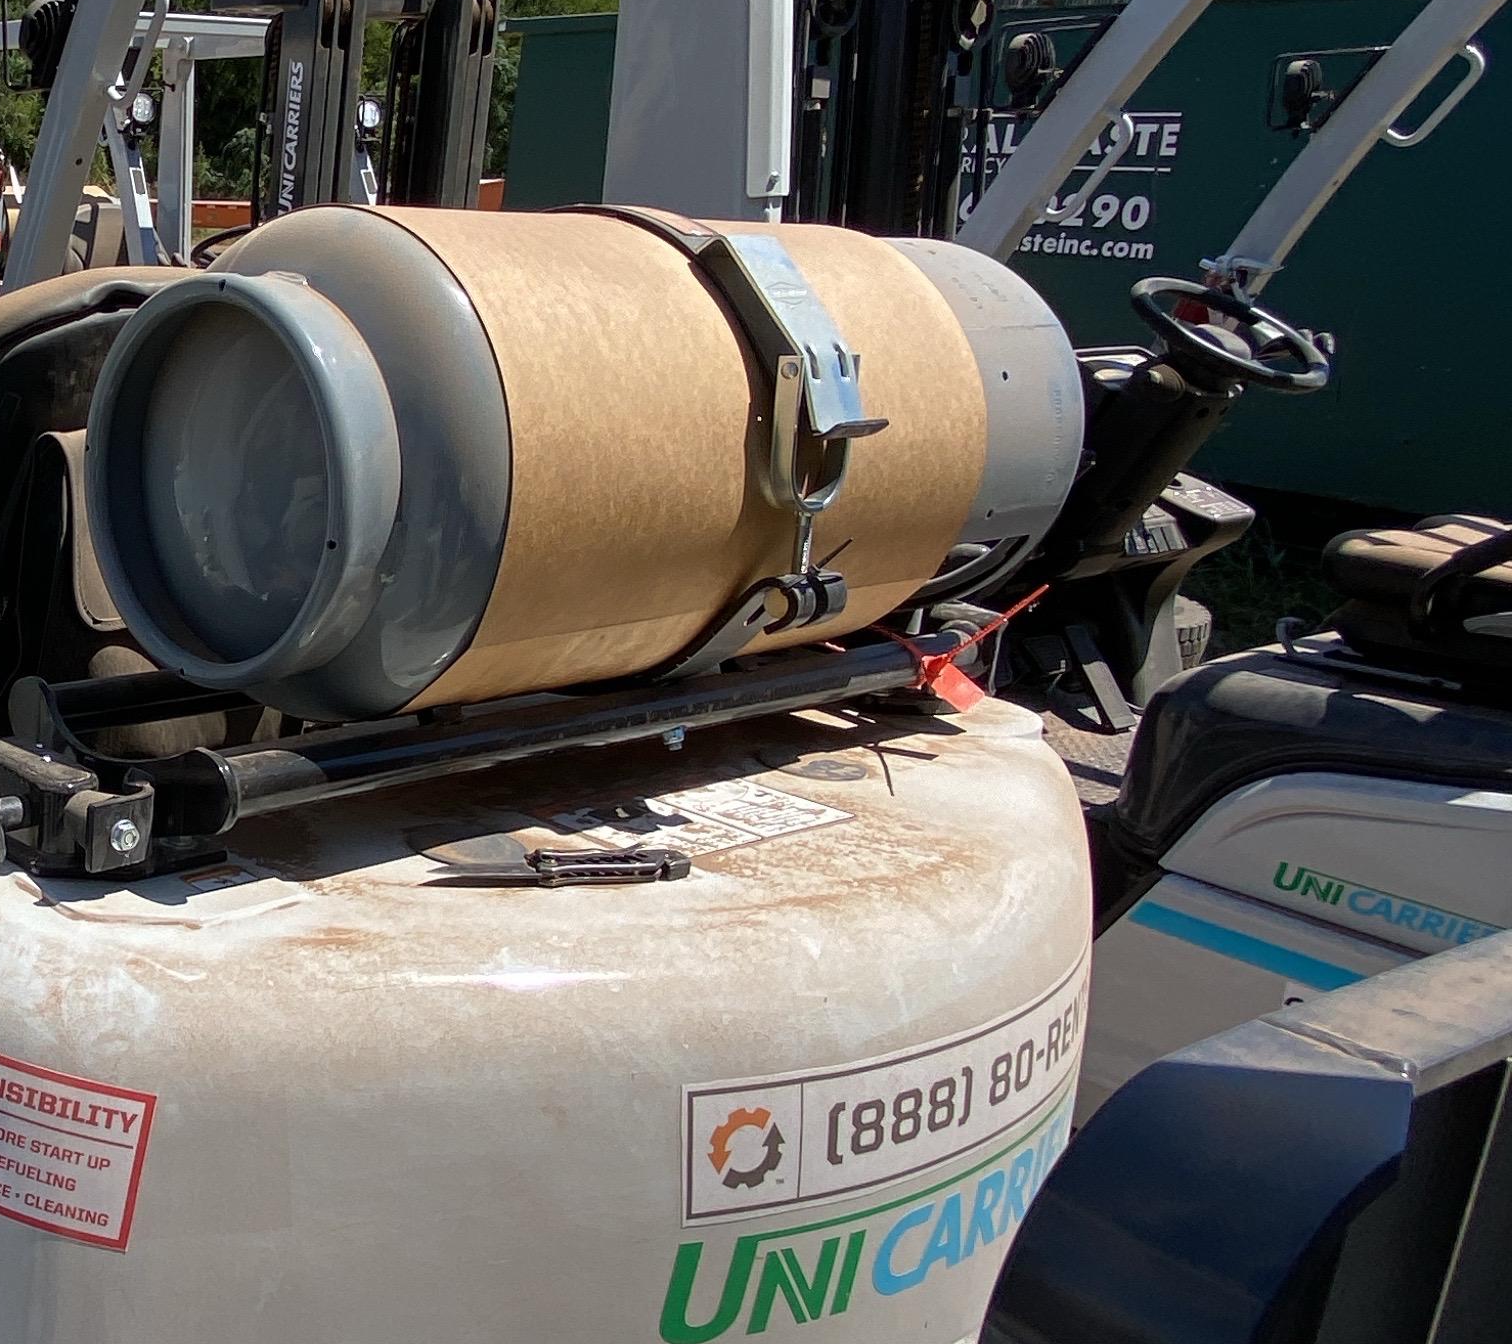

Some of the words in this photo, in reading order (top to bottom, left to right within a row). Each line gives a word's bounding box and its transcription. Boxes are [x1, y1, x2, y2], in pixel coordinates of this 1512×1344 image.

[1016, 231, 1154, 261] steinc.com
[1272, 861, 1498, 946] UNICARRIE
[826, 1065, 974, 1166] (888)
[988, 981, 1086, 1107] 80-REN
[29, 1139, 85, 1166] START
[88, 1156, 111, 1171] UP
[23, 1192, 110, 1227] CLEANING
